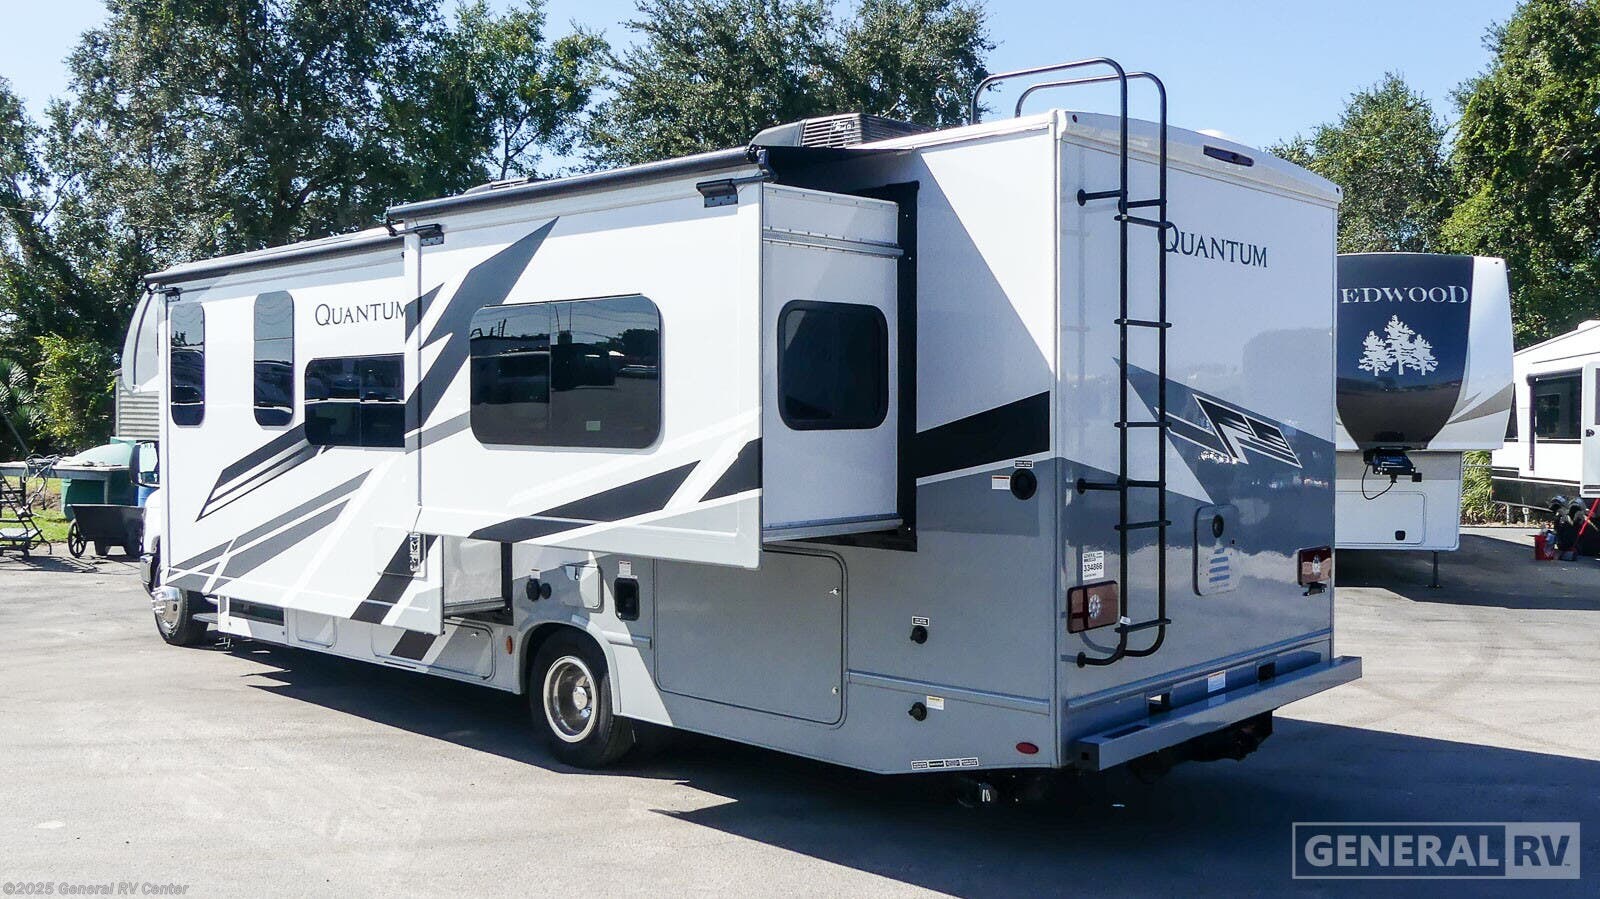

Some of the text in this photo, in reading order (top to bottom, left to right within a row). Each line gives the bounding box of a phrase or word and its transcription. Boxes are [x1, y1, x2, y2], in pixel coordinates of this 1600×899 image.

[1157, 221, 1268, 268] QUANTUM
[1340, 285, 1469, 304] EDWOOD
[315, 301, 406, 326] QUANTUM
